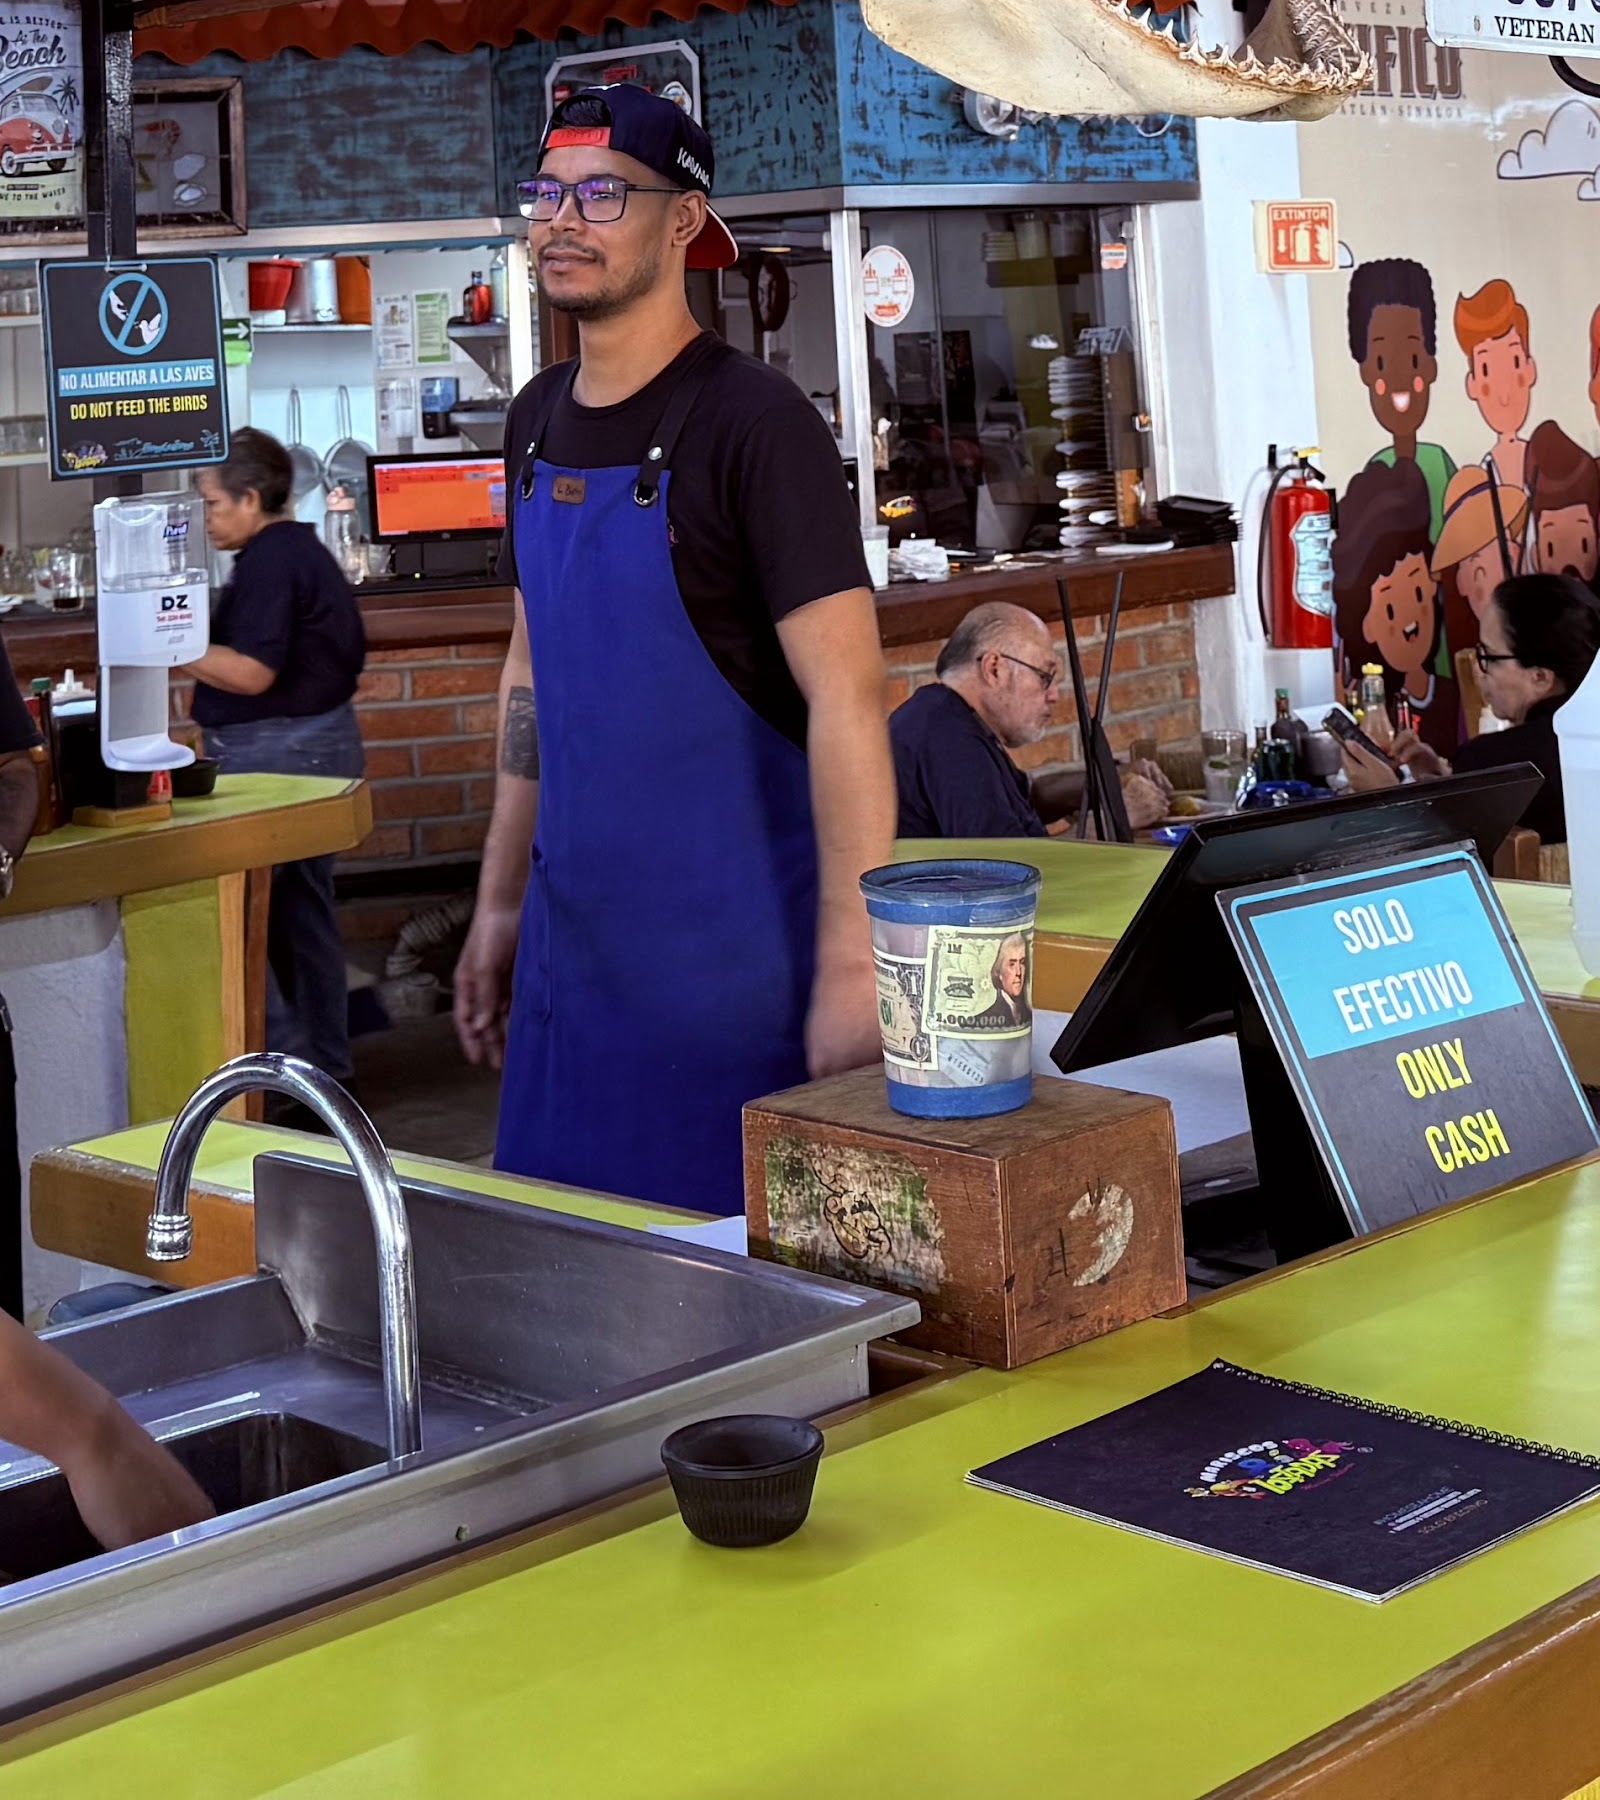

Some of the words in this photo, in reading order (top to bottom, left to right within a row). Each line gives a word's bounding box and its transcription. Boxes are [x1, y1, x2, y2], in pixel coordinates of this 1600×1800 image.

[1494, 16, 1596, 44] VETERAN
[1273, 208, 1329, 222] EXTINTOR
[81, 370, 148, 389] ALIMENTAR
[160, 366, 183, 384] LAS
[184, 364, 215, 382] AVES
[70, 403, 87, 421] DO
[90, 400, 114, 419] NOT
[116, 398, 146, 417] FEED
[148, 396, 171, 415] THE
[173, 394, 208, 413] BIRDS
[1332, 897, 1414, 954] SOLO
[1331, 960, 1476, 1035] EFECTIVO
[1394, 1038, 1476, 1101] ONLY
[1423, 1108, 1511, 1175] CASH
